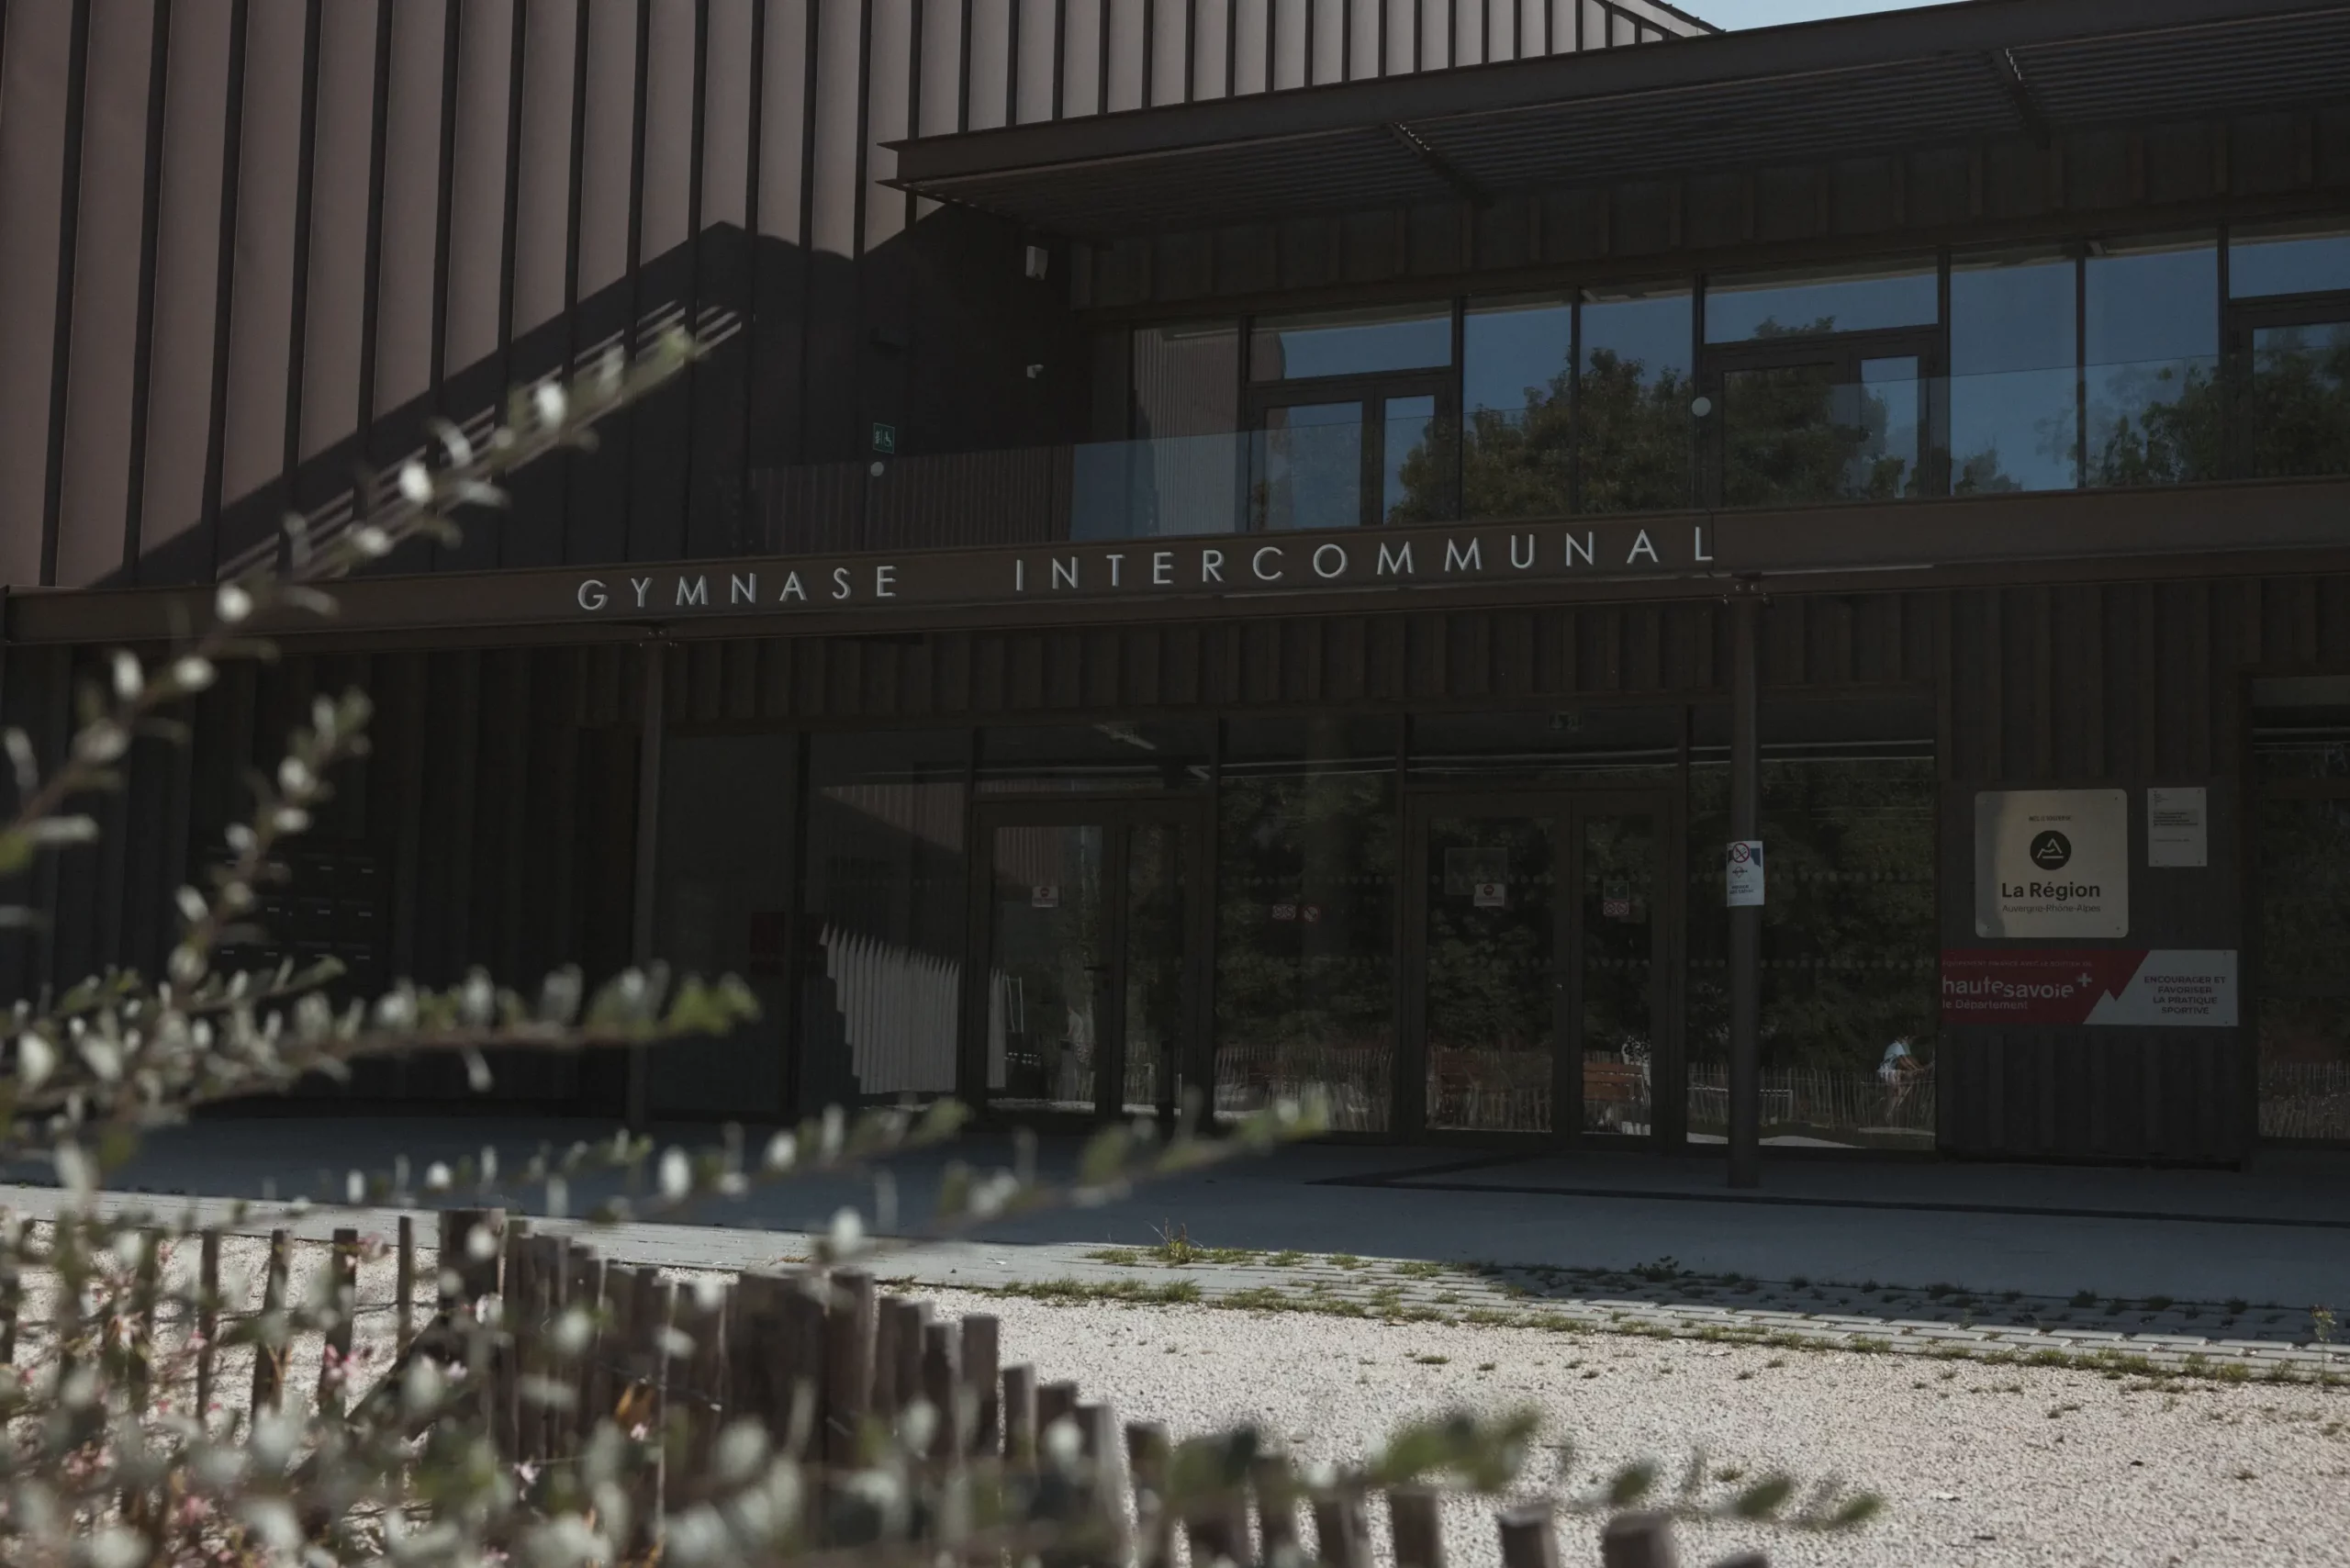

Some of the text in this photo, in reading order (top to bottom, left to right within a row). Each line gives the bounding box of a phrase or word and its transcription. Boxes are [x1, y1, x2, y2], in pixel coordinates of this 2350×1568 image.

[577, 526, 1714, 610] GYMNASE INTERCOMMUNAL
[2001, 881, 2100, 901] La Région
[2143, 976, 2226, 984] ENCOURAGER ET
[2157, 986, 2212, 994] FAVORISER
[1942, 999, 2028, 1010] le Département
[2167, 996, 2218, 1005] PRATIQUE
[2161, 1006, 2210, 1014] SPORTIVE
